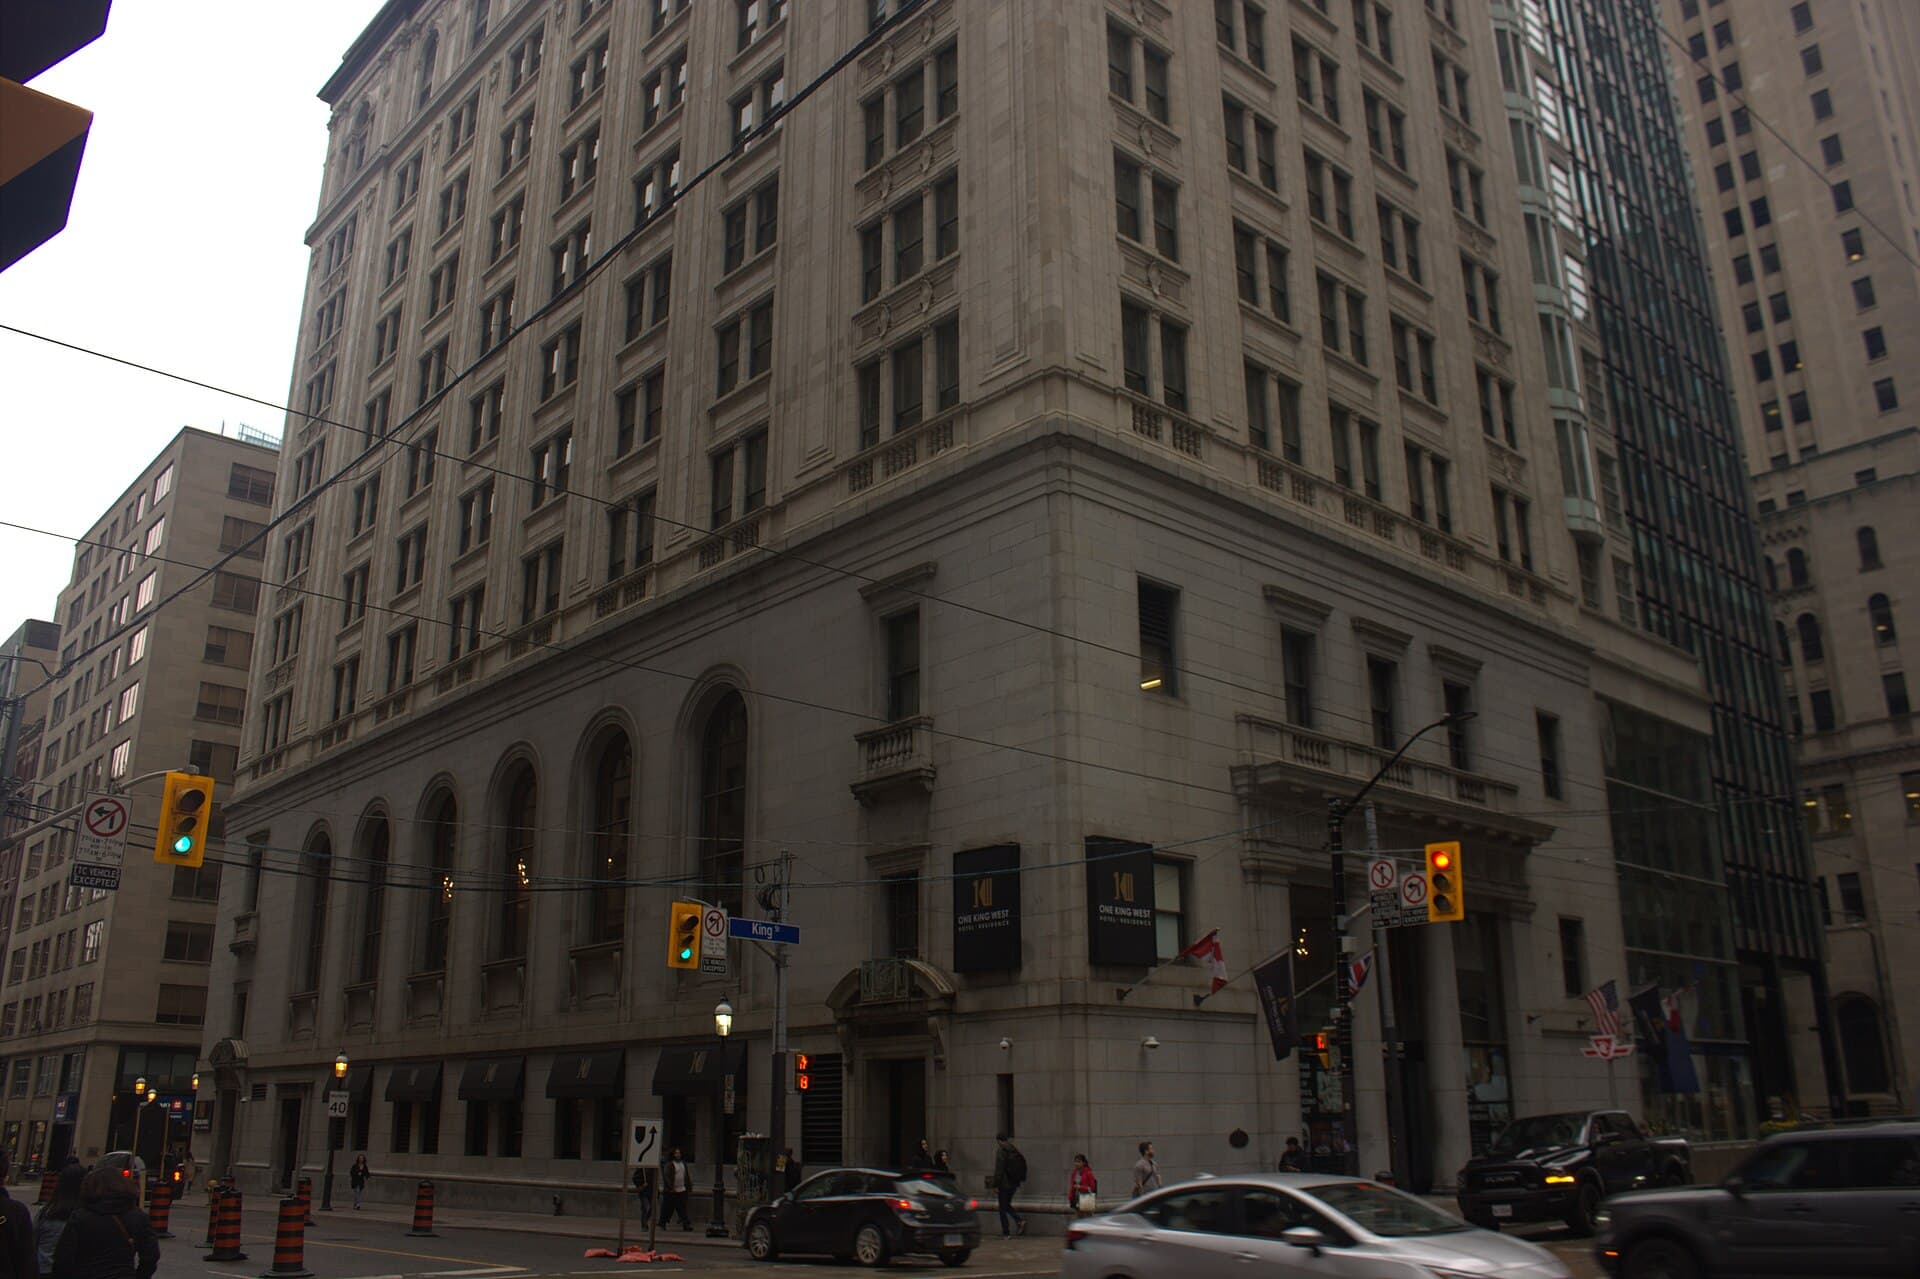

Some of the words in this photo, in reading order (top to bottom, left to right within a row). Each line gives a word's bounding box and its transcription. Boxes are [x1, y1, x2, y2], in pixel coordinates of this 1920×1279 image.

[73, 875, 118, 888] EXCEPTED
[958, 914, 972, 925] ONE
[972, 911, 990, 923] KING
[990, 908, 1009, 920] WEST
[1098, 904, 1114, 914] ONE
[1114, 905, 1132, 916] KING
[1132, 907, 1151, 918] WEST
[751, 922, 773, 939] King
[330, 1102, 346, 1113] 40
